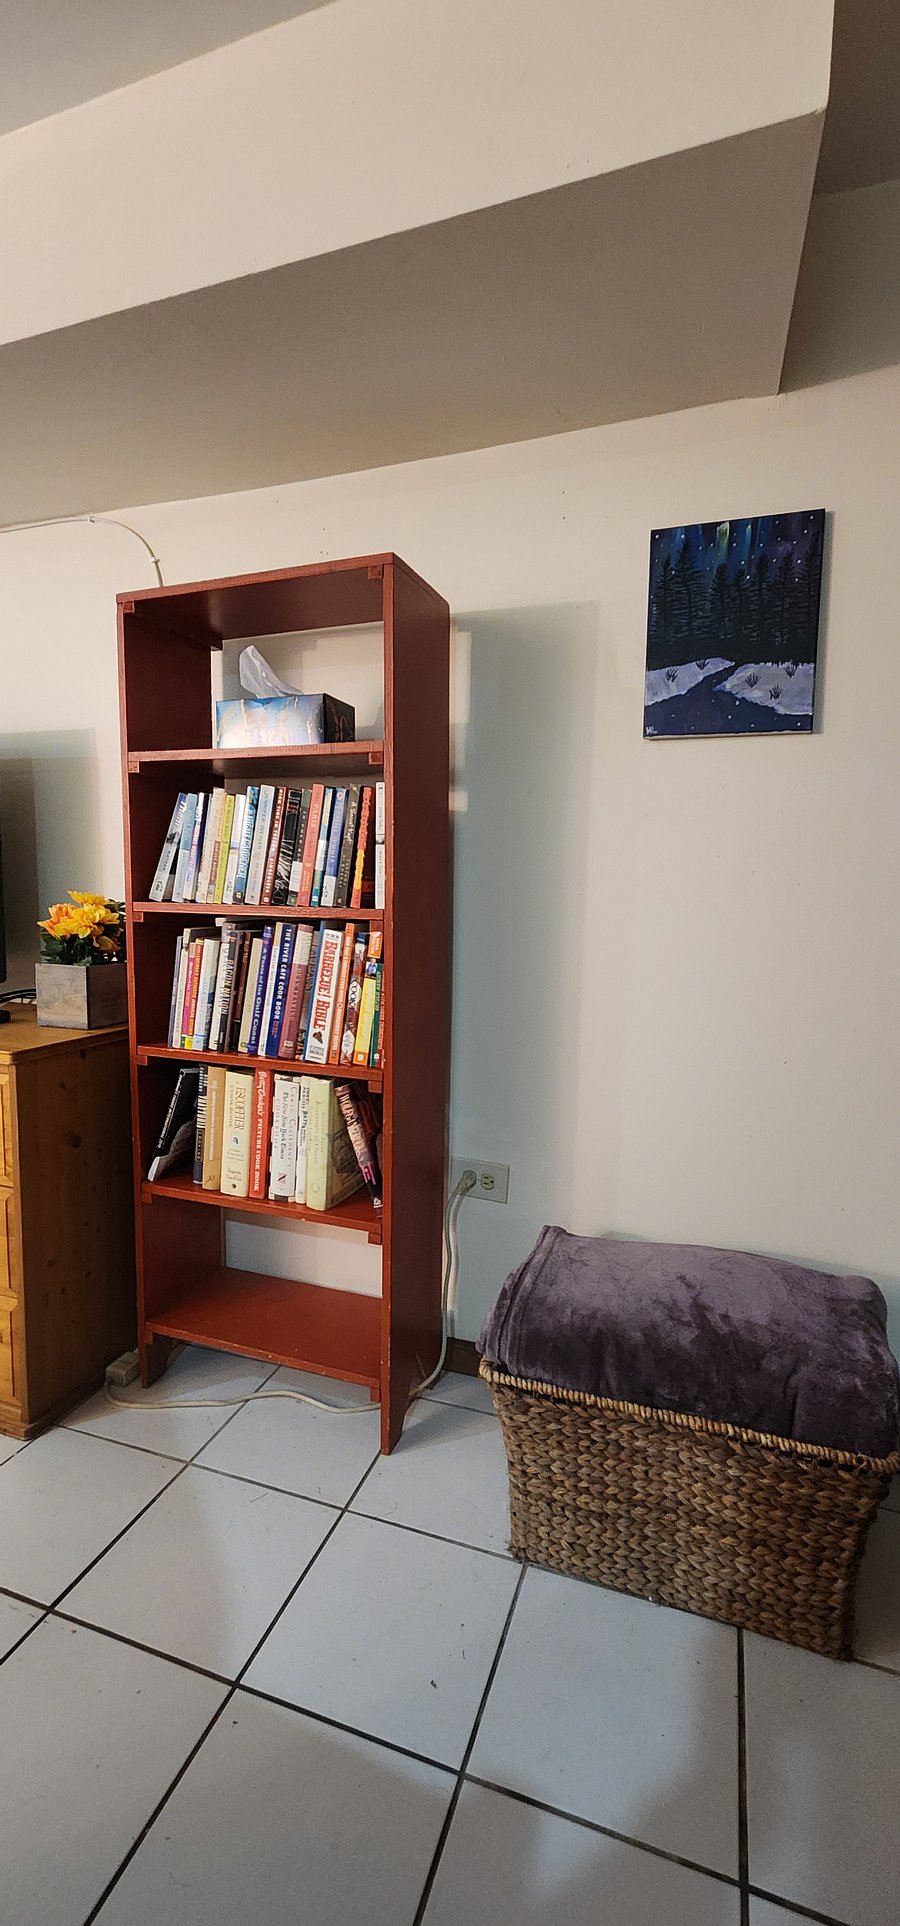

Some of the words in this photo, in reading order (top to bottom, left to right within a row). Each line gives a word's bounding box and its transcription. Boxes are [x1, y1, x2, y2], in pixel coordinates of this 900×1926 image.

[175, 801, 187, 826] Them
[260, 789, 270, 824] JENNIFER
[348, 808, 357, 828] Secret
[243, 816, 255, 840] NIGHT
[257, 824, 266, 850] WEINER
[162, 850, 171, 872] NATHAN
[236, 839, 252, 880] GARDENER
[284, 928, 292, 940] THE
[282, 942, 290, 962] RIVER
[224, 959, 234, 986] BACON
[258, 975, 264, 983] of
[279, 964, 288, 980] CAFE
[318, 940, 338, 997] BARBECUE!
[221, 987, 231, 1015] NATION
[276, 981, 285, 1000] COOK
[254, 996, 263, 1018] Gulf
[274, 1001, 282, 1020] BOOK
[313, 999, 330, 1030] BIBLE
[250, 1018, 261, 1045] Coast
[256, 1071, 267, 1089] Betty
[234, 1087, 246, 1130] ESCOFFIER
[257, 1088, 266, 1116] Crocker's
[160, 1108, 173, 1138] INTERNATIONAL
[279, 1128, 287, 1141] York
